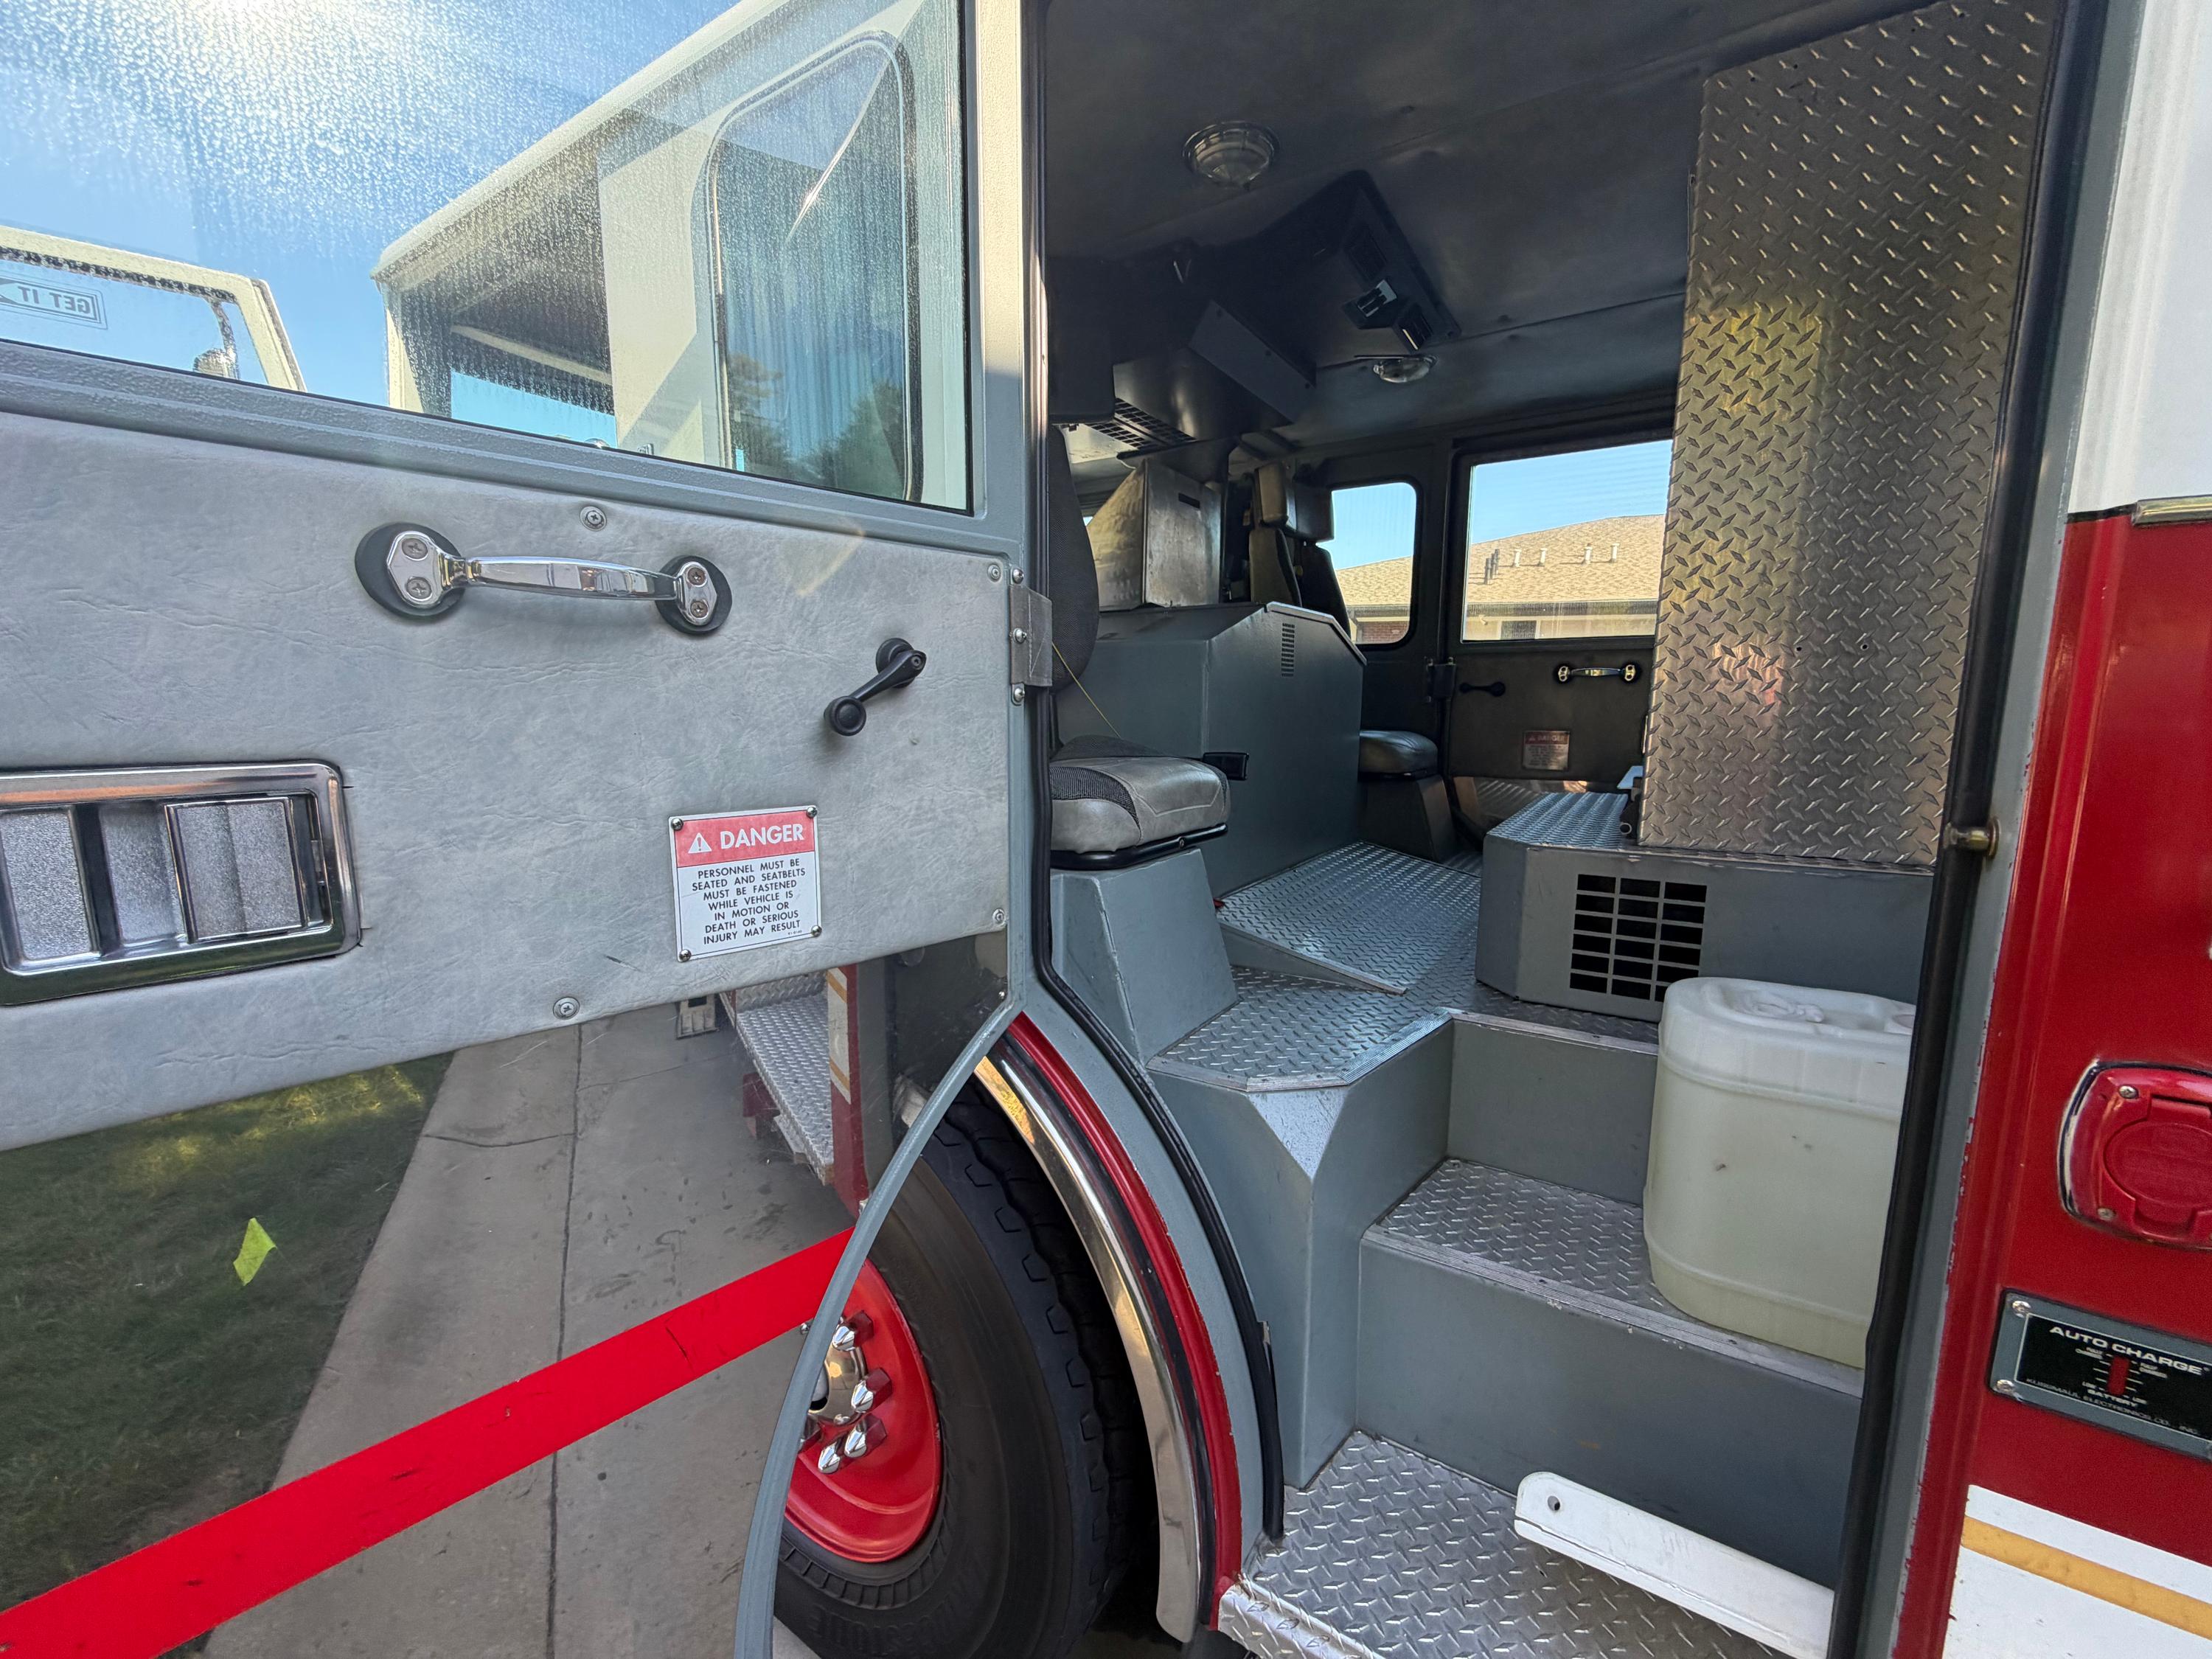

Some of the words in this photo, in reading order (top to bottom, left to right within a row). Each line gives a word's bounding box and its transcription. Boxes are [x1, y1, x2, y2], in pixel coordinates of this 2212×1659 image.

[720, 823, 804, 849] DANGER
[692, 879, 728, 891] SEATED
[734, 875, 756, 886] AND
[761, 868, 806, 882] SEATBELTS
[698, 864, 754, 880] PERSONNEL
[760, 860, 784, 872] MUST
[790, 858, 800, 867] BE
[703, 889, 730, 901] MUST
[737, 887, 747, 896] BE
[753, 880, 797, 894] FASTENED
[708, 899, 738, 911] WHILE
[744, 893, 780, 905] VEHICLE
[785, 891, 793, 899] IS
[705, 921, 737, 933] DEATH
[742, 918, 757, 928] OR
[762, 910, 799, 924] SERIOUS
[714, 912, 725, 921] IN
[731, 905, 771, 919] MOTION
[776, 901, 789, 911] OR
[703, 931, 738, 945] INJURY
[744, 926, 765, 939] MAY
[771, 919, 801, 932] RESULT
[2049, 1326, 2108, 1349] AUTO
[2087, 1389, 2138, 1408] BATTERY
